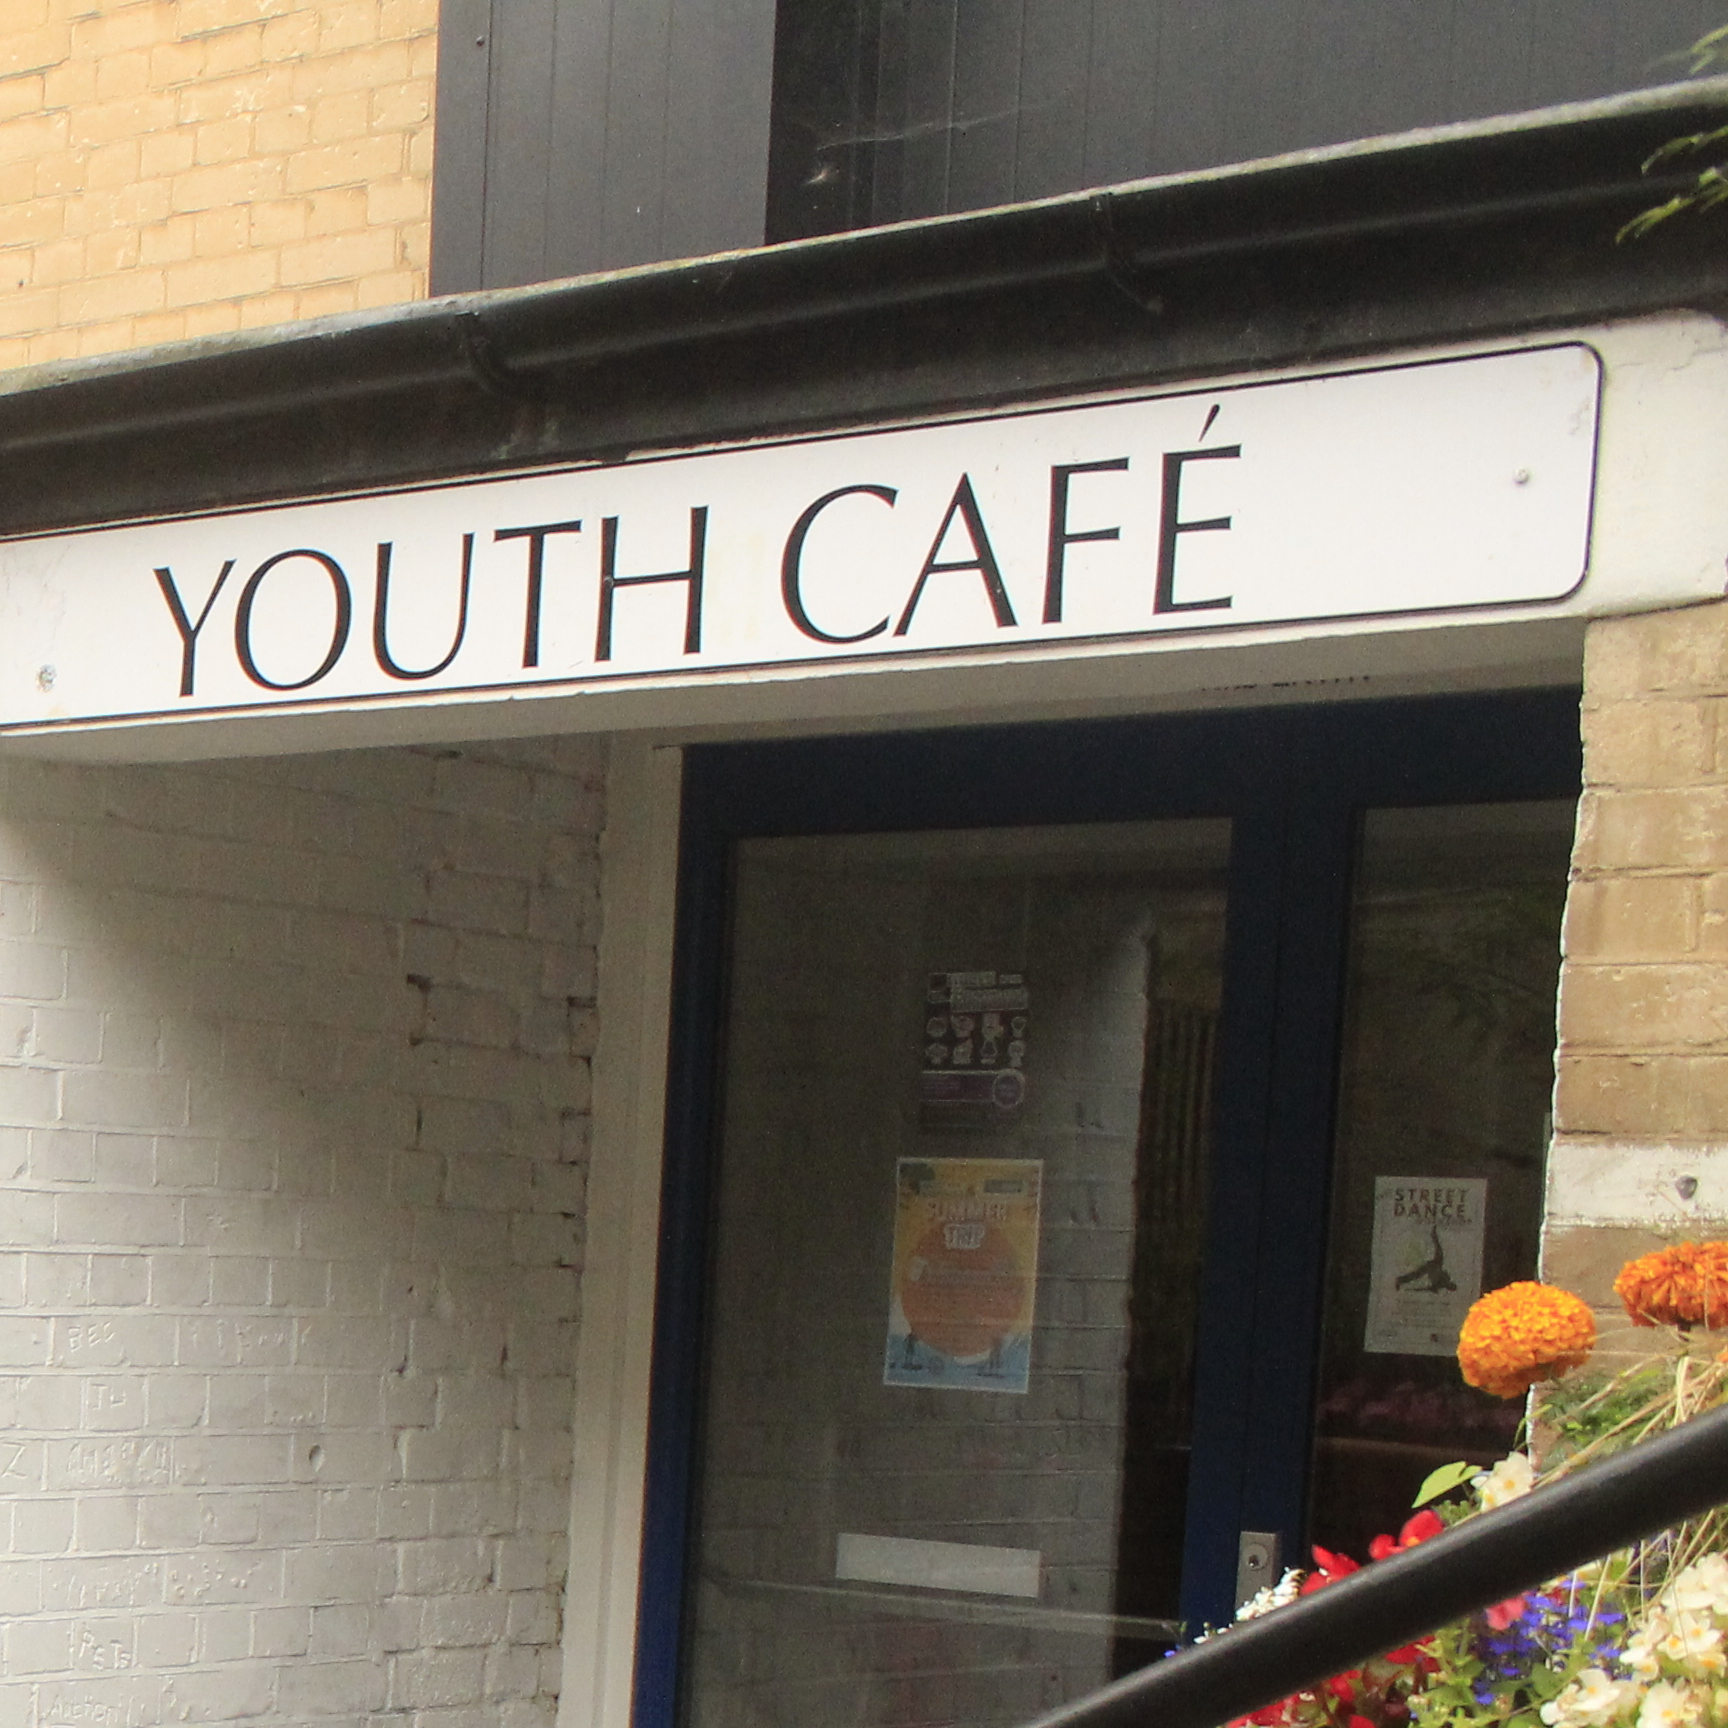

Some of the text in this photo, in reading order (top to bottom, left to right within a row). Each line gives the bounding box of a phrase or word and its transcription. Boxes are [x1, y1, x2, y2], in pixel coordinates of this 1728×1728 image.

[154, 405, 1243, 697] YOUTH CAFÉ
[1395, 1188, 1470, 1202] STREET
[1394, 1203, 1466, 1218] DANCE
